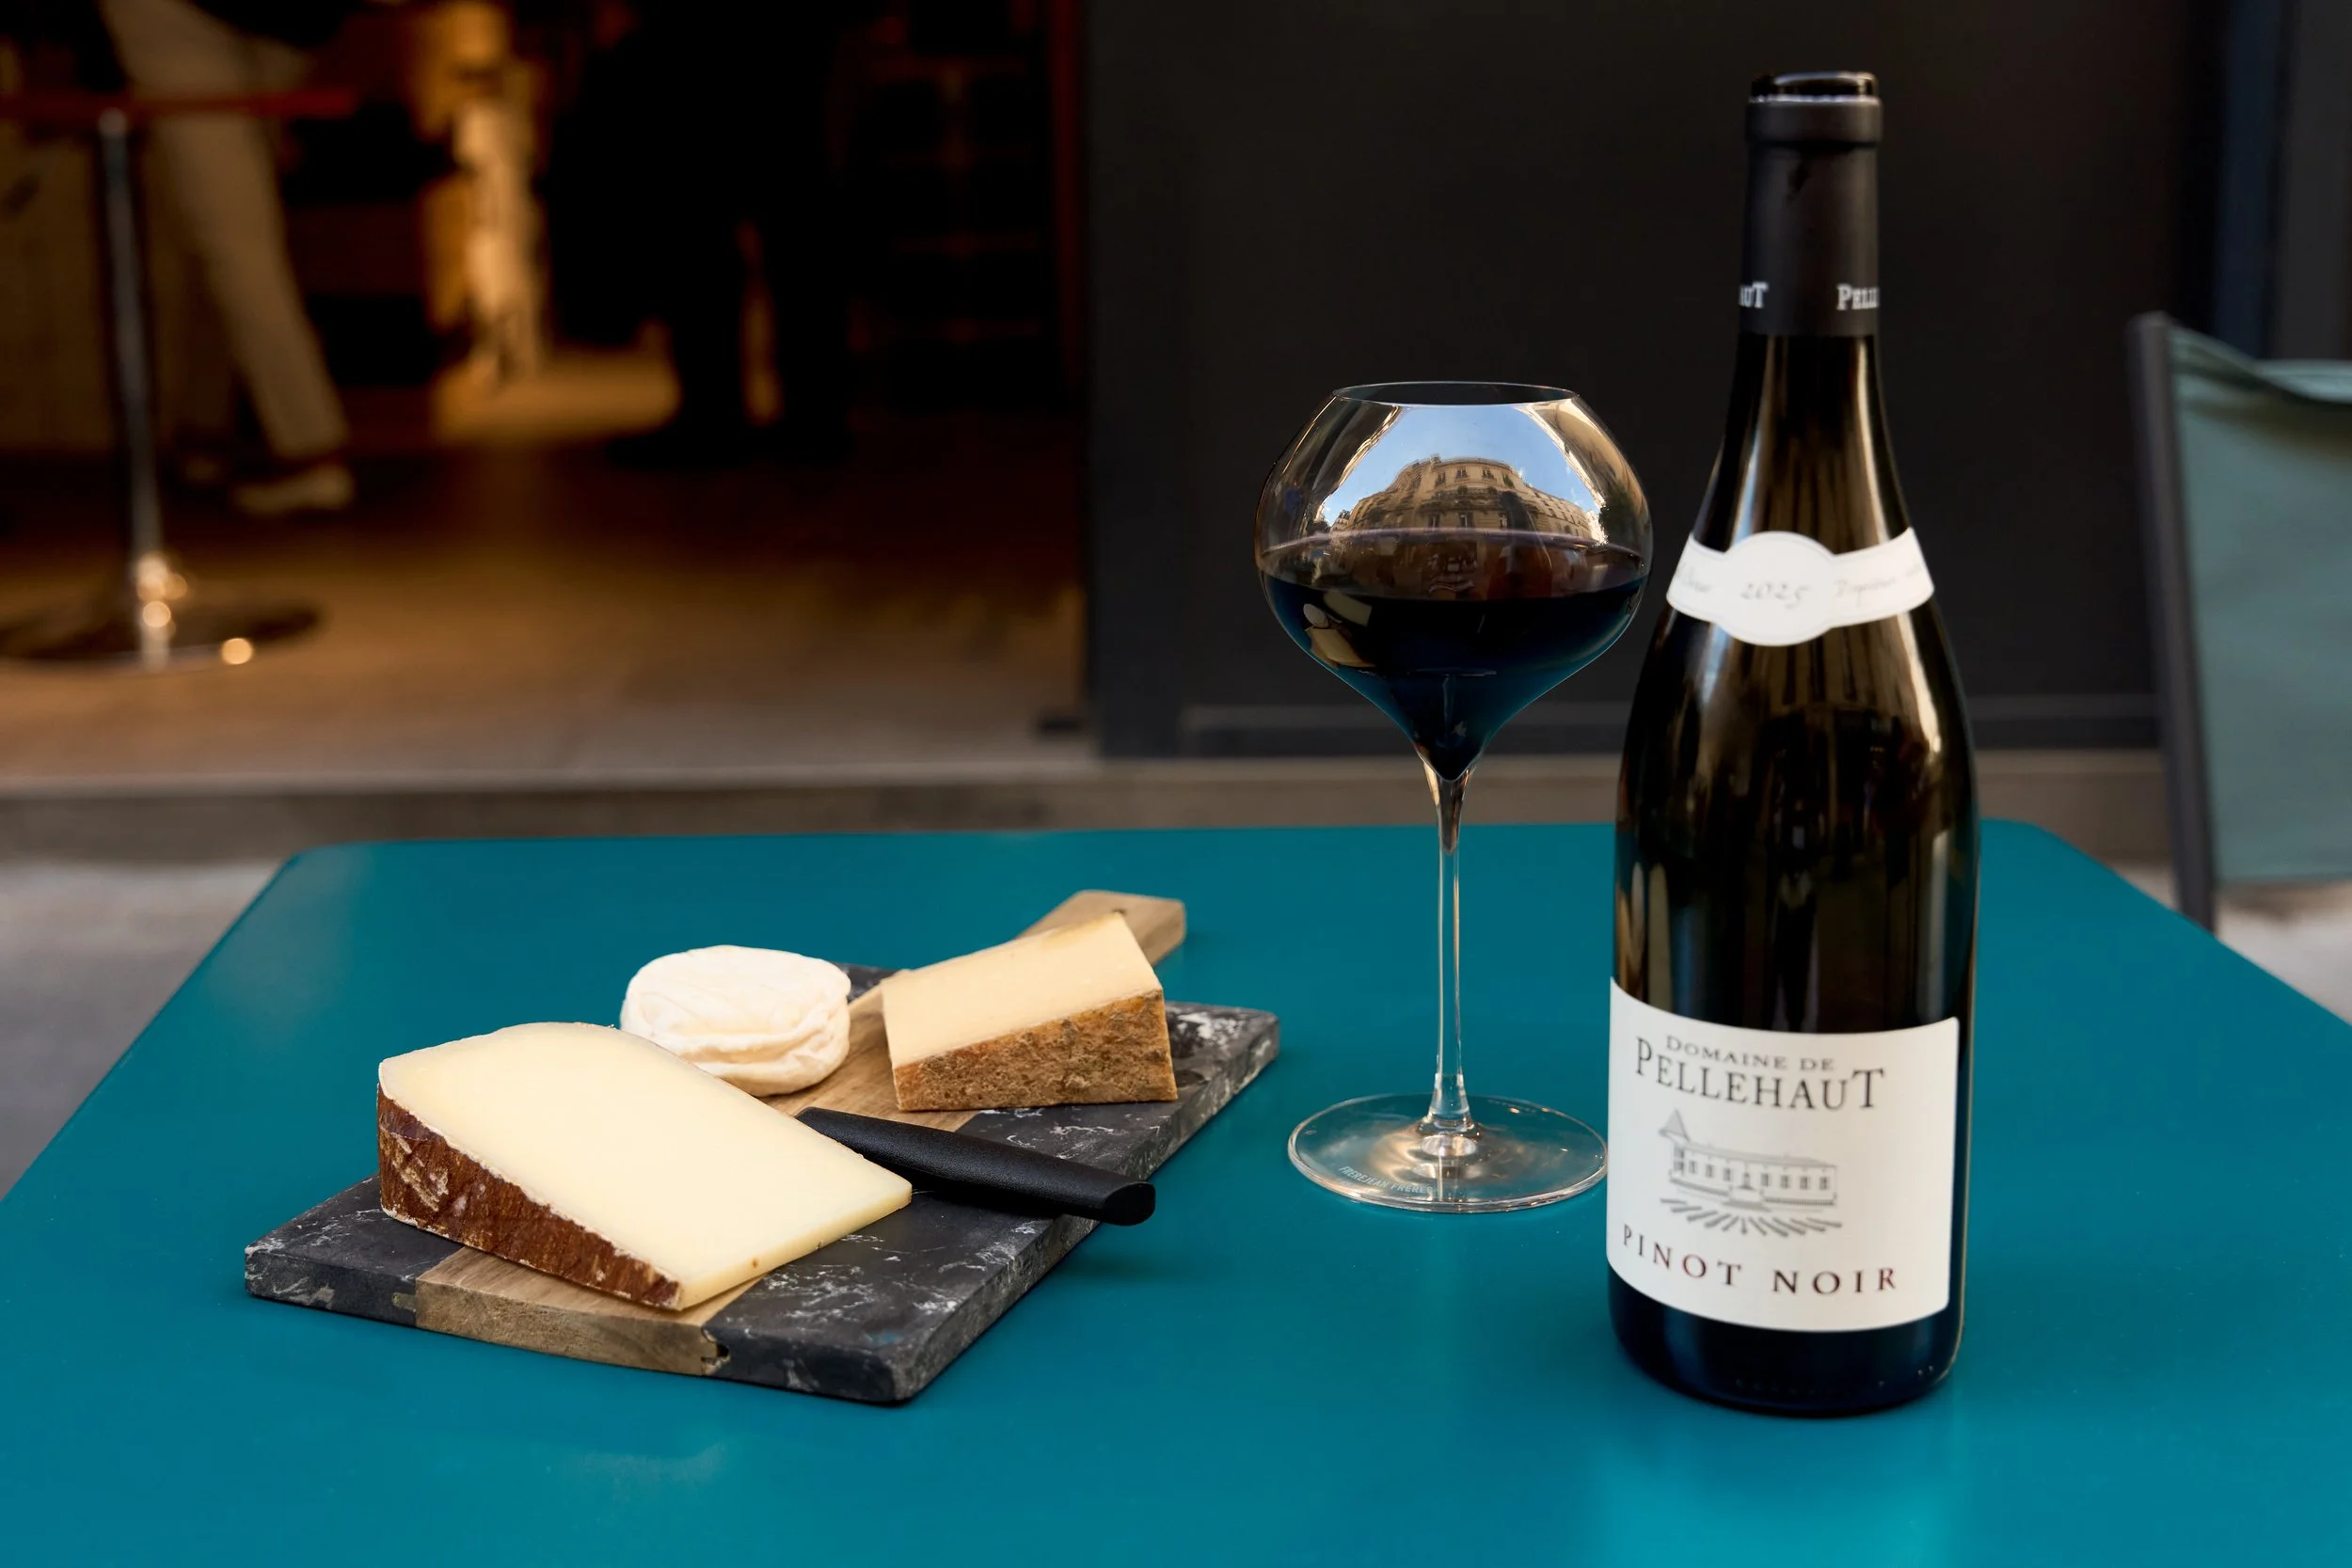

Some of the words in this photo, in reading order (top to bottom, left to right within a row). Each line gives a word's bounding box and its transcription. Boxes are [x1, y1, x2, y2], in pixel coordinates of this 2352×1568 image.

[1740, 580, 1810, 610] 2025
[1636, 1037, 1885, 1111] PELLEHAUT
[1666, 1035, 1788, 1070] DOMAINE
[1800, 1057, 1836, 1071] DE
[1623, 1225, 1741, 1286] PINOT
[1772, 1268, 1898, 1295] NOIR
